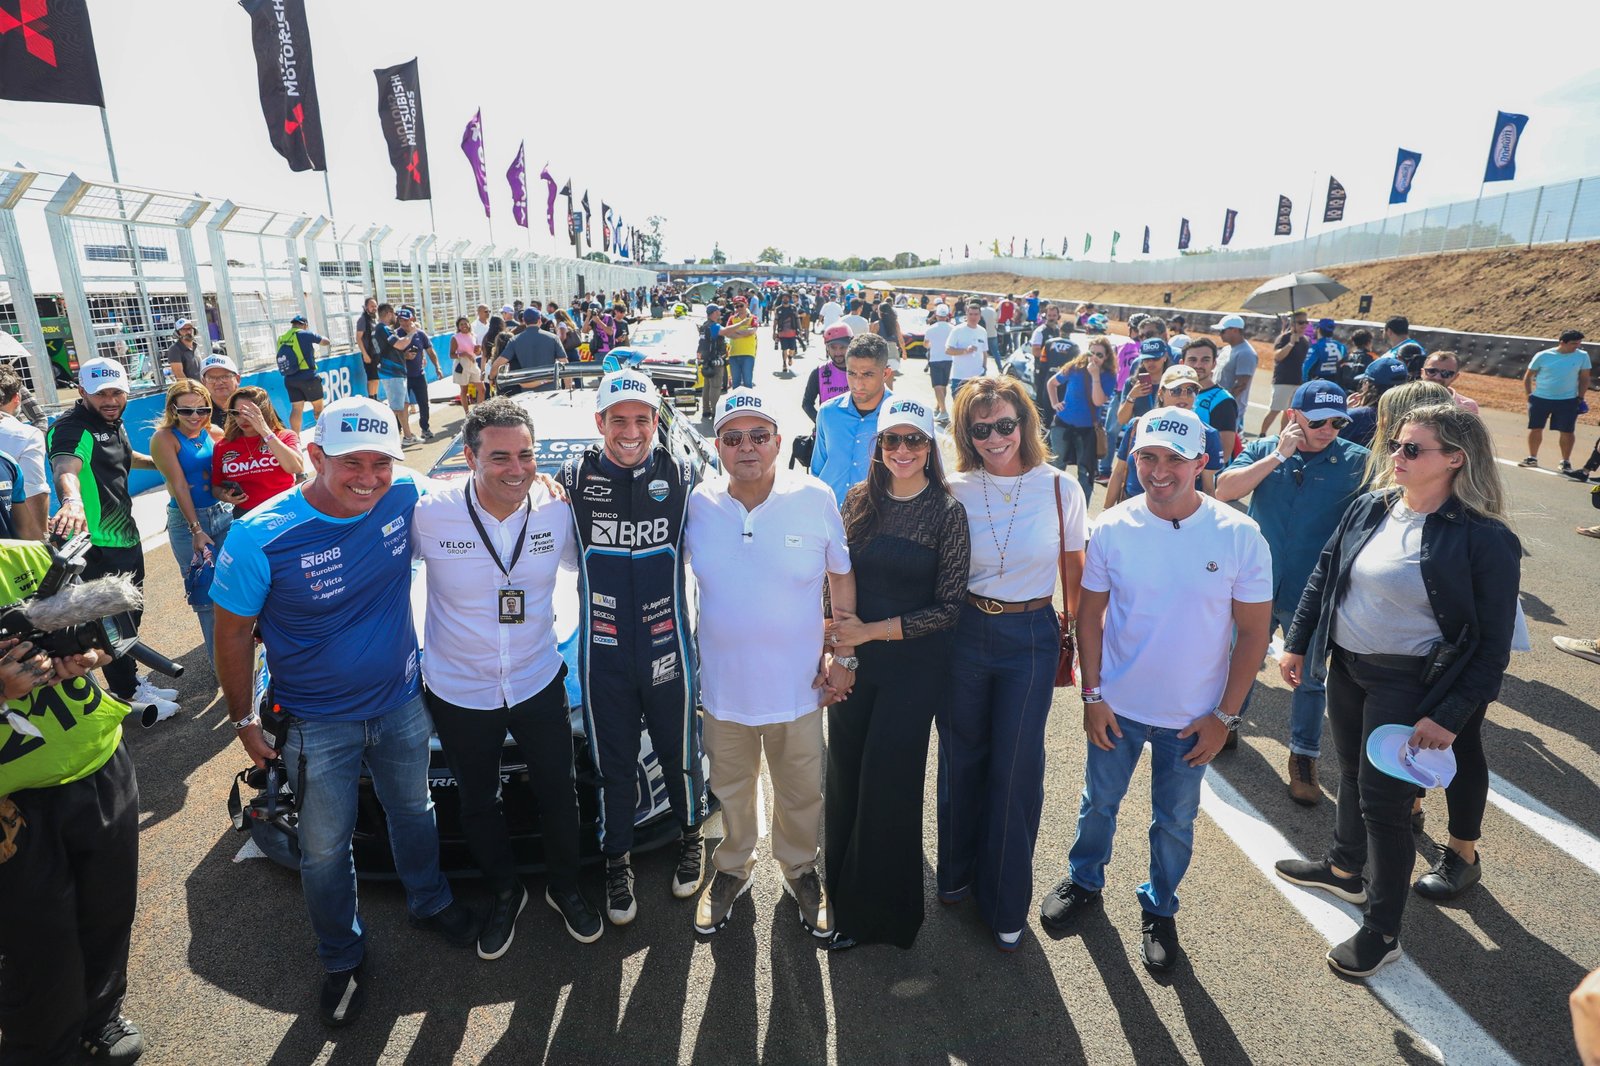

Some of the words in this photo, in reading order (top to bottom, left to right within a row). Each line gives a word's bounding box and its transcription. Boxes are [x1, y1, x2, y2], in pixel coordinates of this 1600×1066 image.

[101, 369, 120, 378] BRB
[623, 380, 647, 393] BRB
[737, 396, 762, 408] BRB
[1326, 394, 1343, 404] BRB
[902, 402, 925, 417] BRB
[358, 419, 389, 435] BRB
[1158, 420, 1189, 436] BRB
[583, 495, 612, 503] CHEVROLET
[276, 511, 297, 527] BRB
[592, 511, 618, 519] banco
[619, 517, 669, 547] BRB
[440, 541, 475, 549] VELOCI
[314, 546, 342, 566] BRB
[311, 563, 343, 578] Eurobike
[323, 577, 343, 587] Victa
[647, 608, 672, 621] Eurobike
[652, 652, 676, 679] 12
